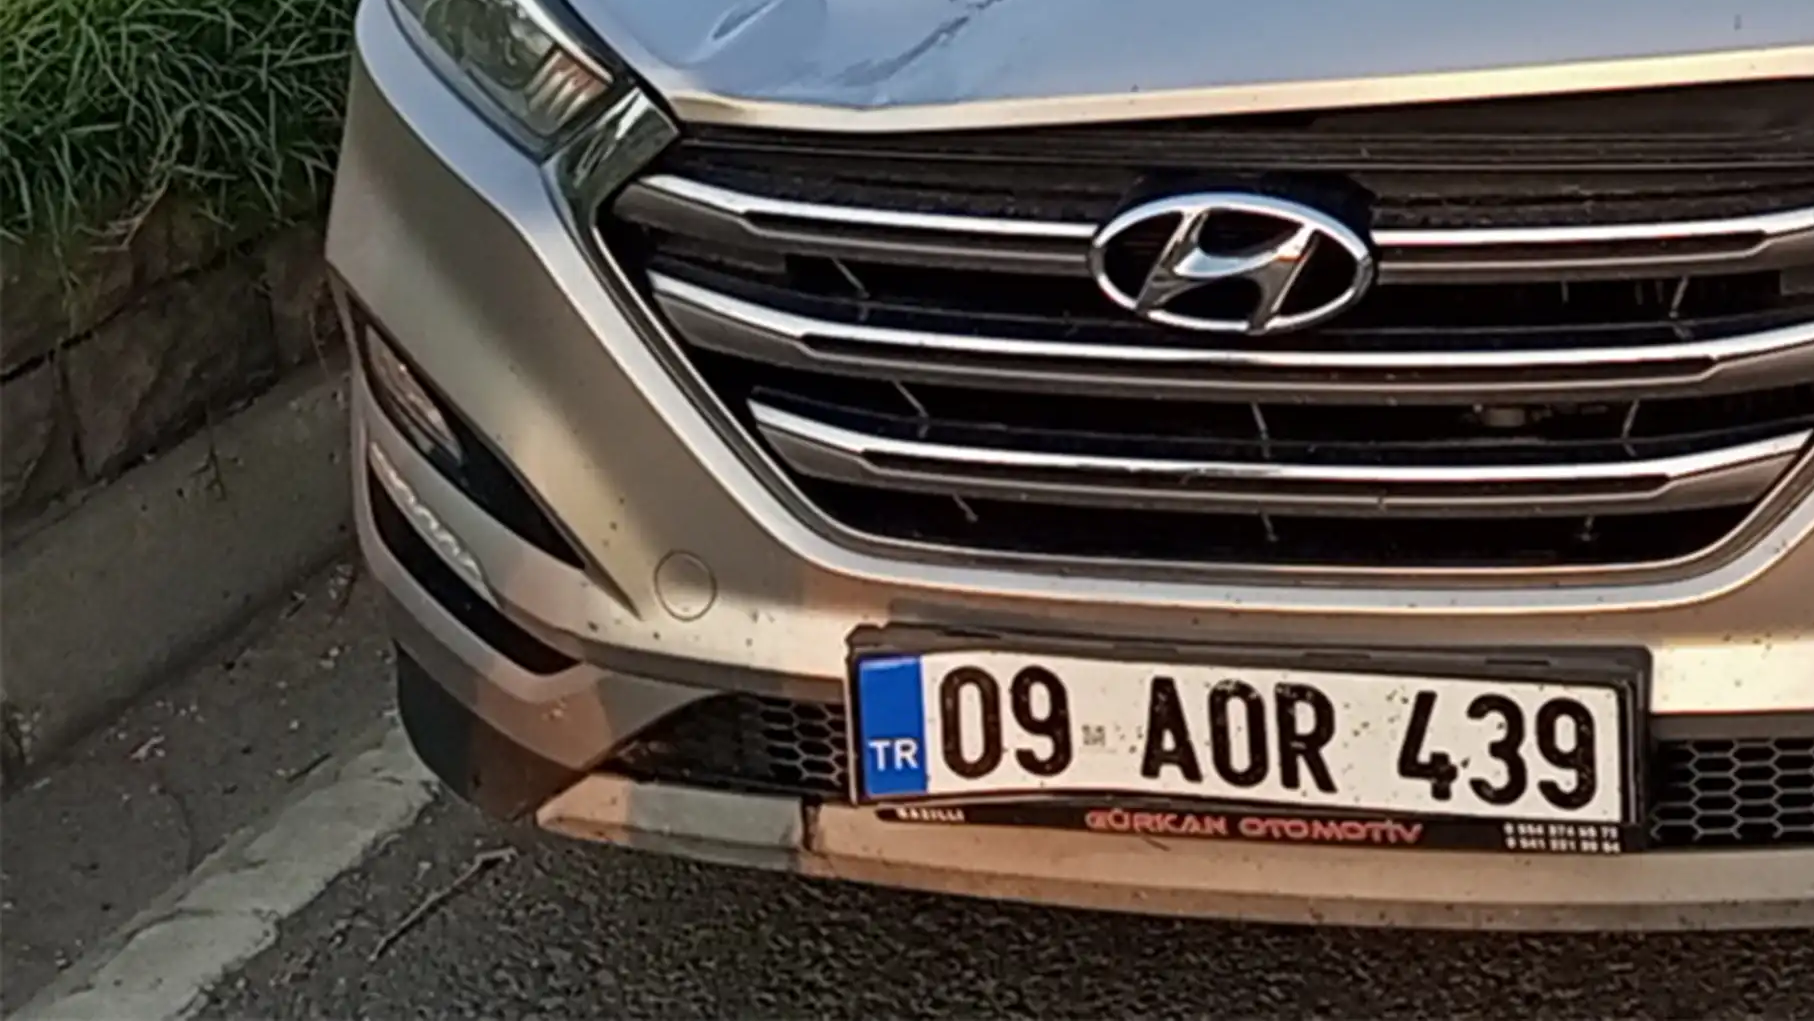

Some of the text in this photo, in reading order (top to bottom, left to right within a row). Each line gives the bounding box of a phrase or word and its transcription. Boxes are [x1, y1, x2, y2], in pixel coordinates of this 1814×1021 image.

[868, 737, 919, 772] TR
[939, 664, 1597, 811] 09 AOR 439
